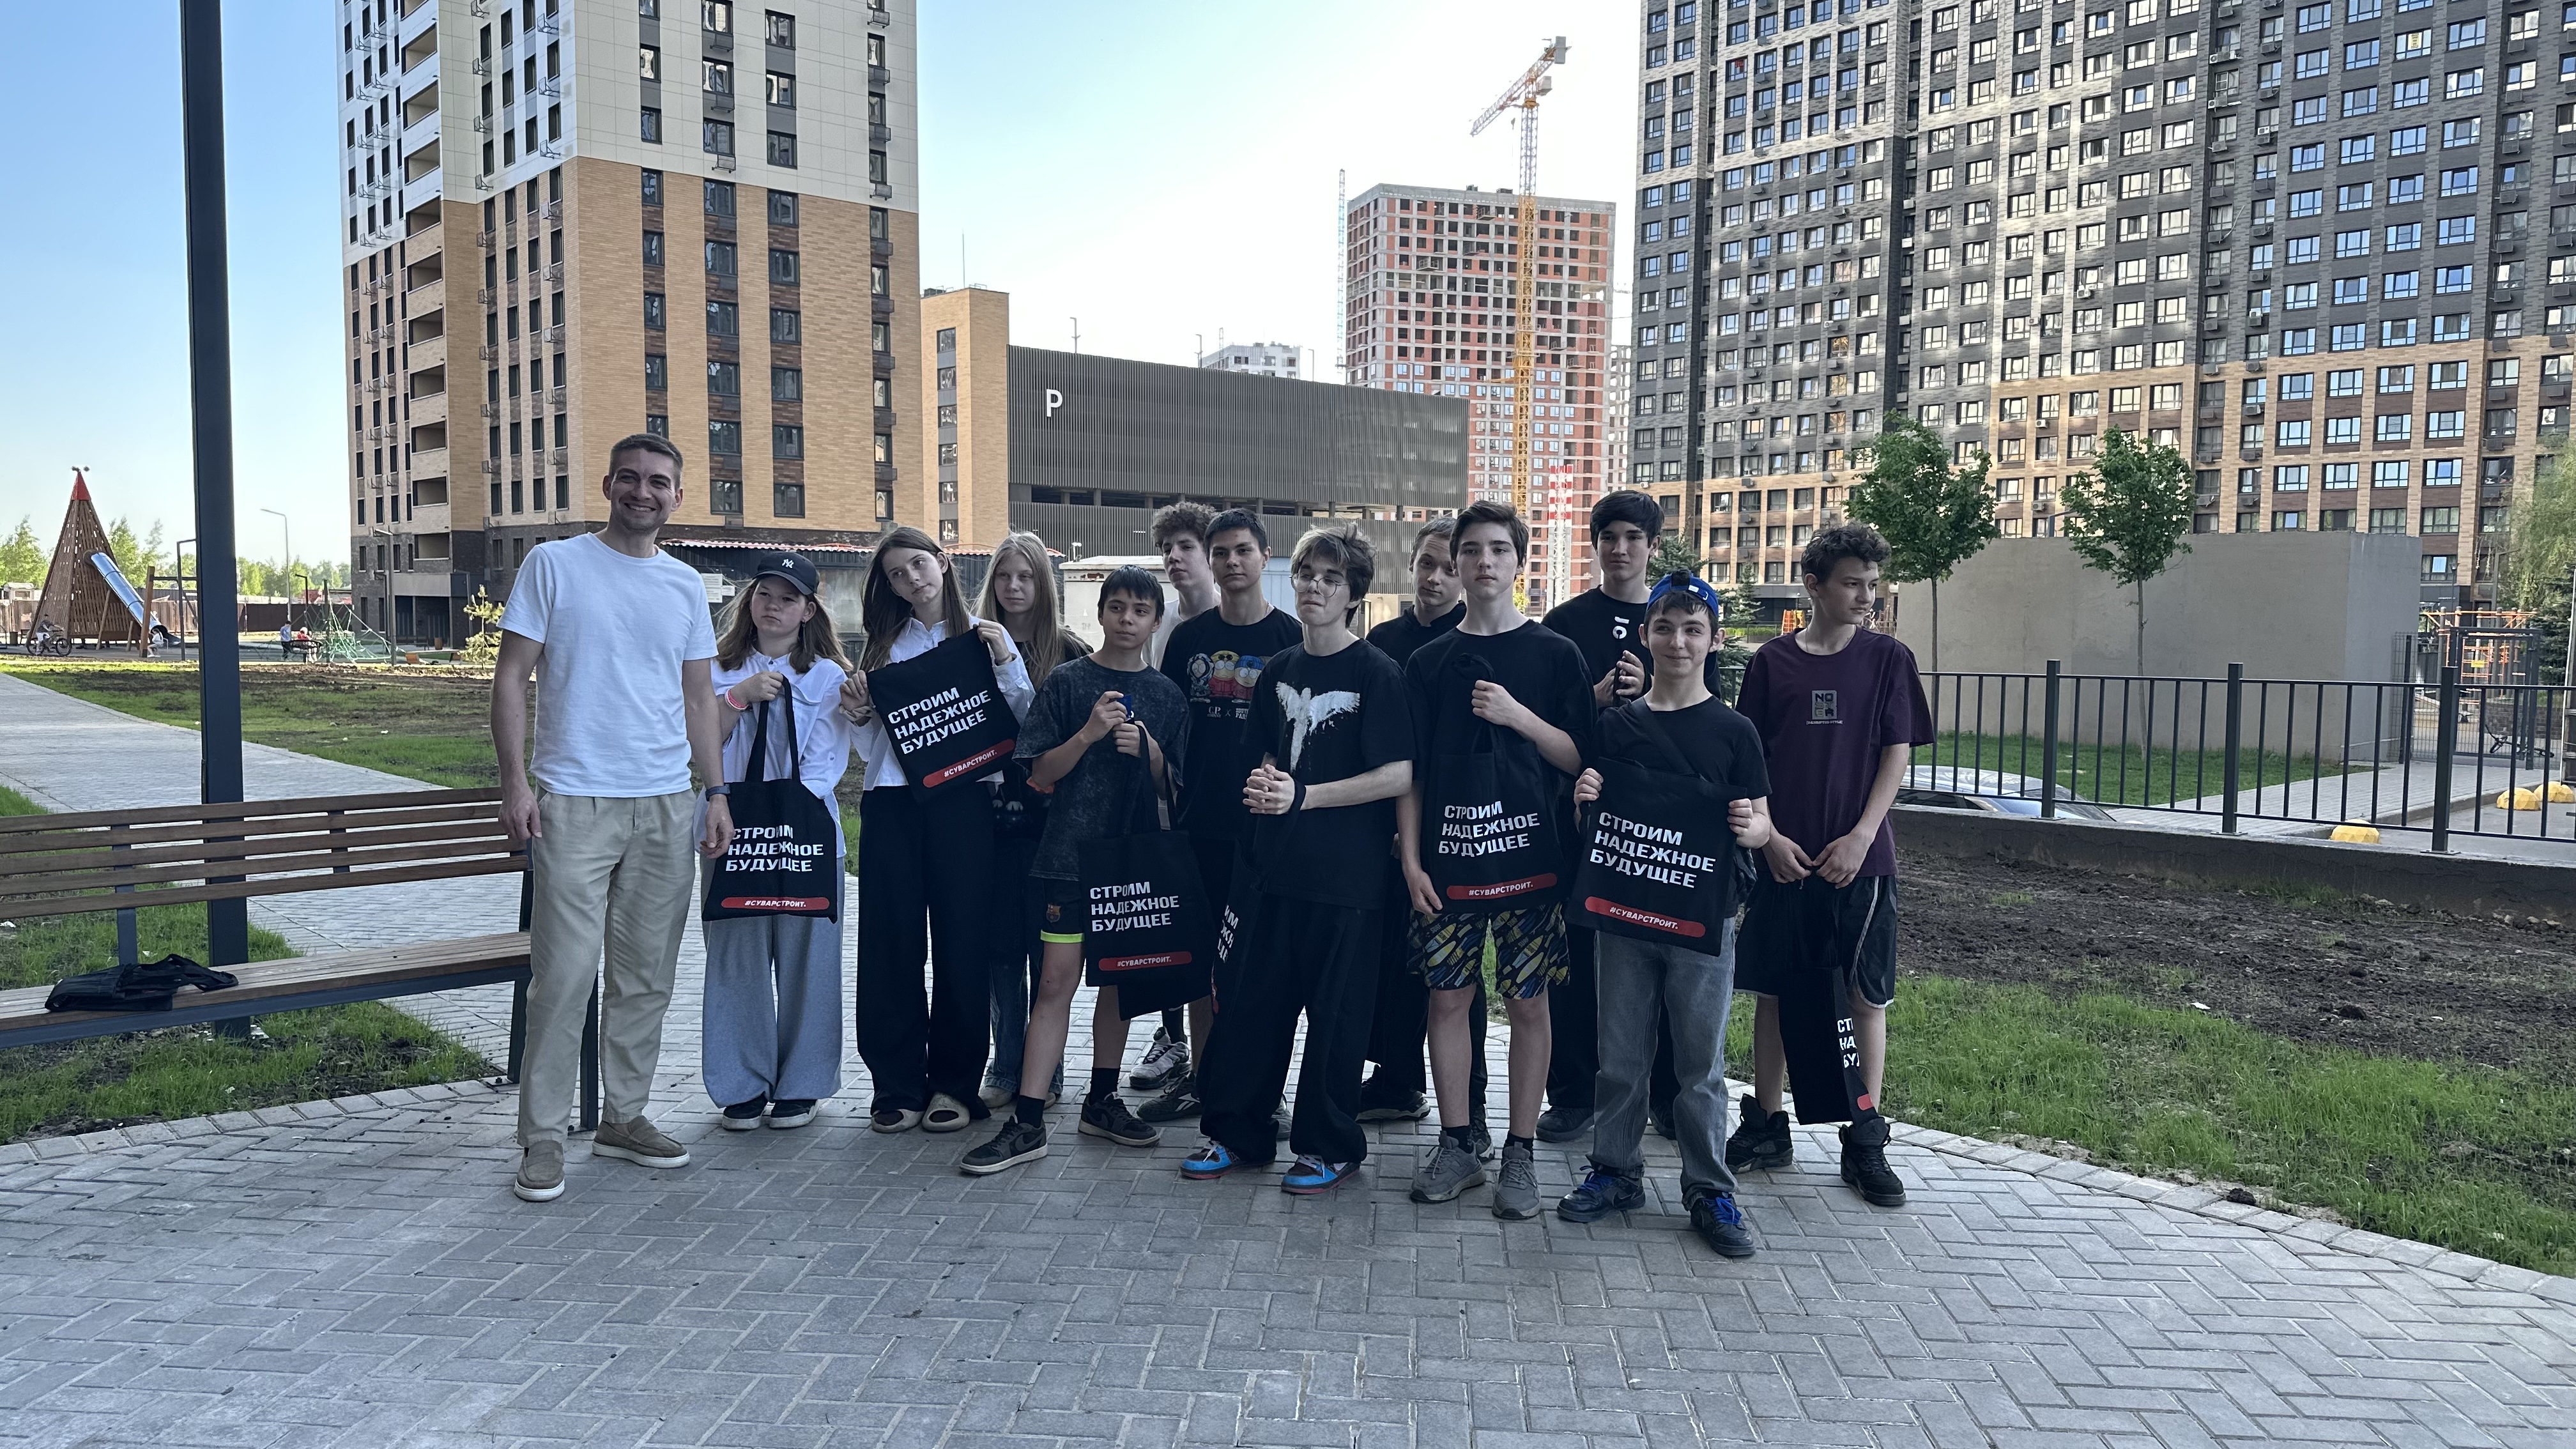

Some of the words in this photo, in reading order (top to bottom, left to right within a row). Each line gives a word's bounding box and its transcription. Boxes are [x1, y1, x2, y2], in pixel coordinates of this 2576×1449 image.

[1046, 388, 1063, 417] P
[887, 687, 960, 724] СТРОИМ
[894, 690, 991, 740] НАДЕЖНОЕ
[900, 709, 987, 755] БУДУЩЕЕ
[944, 749, 997, 778] #СУВАРСТРОИТ.
[1444, 801, 1503, 820] СТРОИМ
[732, 824, 793, 840] СТРОИМ
[1441, 813, 1540, 839] НАДЕЖНОЕ
[1598, 812, 1683, 846] СТРОИМ
[728, 841, 824, 856] НАДЕЖНОЕ
[1438, 833, 1530, 857] БУДУЩЕЕ
[1594, 830, 1716, 872] НАДЕЖНОЕ
[725, 857, 813, 872] БУДУЩЕЕ
[1590, 848, 1697, 888] БУДУЩЕЕ
[1090, 881, 1151, 900] СТРОИМ
[1469, 881, 1533, 896] #СУВАРСТРОИТ.
[1091, 895, 1180, 915] НАДЕЖНОЕ
[1092, 913, 1172, 932] БУДУЩЕЕ
[1609, 906, 1678, 930] #СУВАРСТРОИТ.
